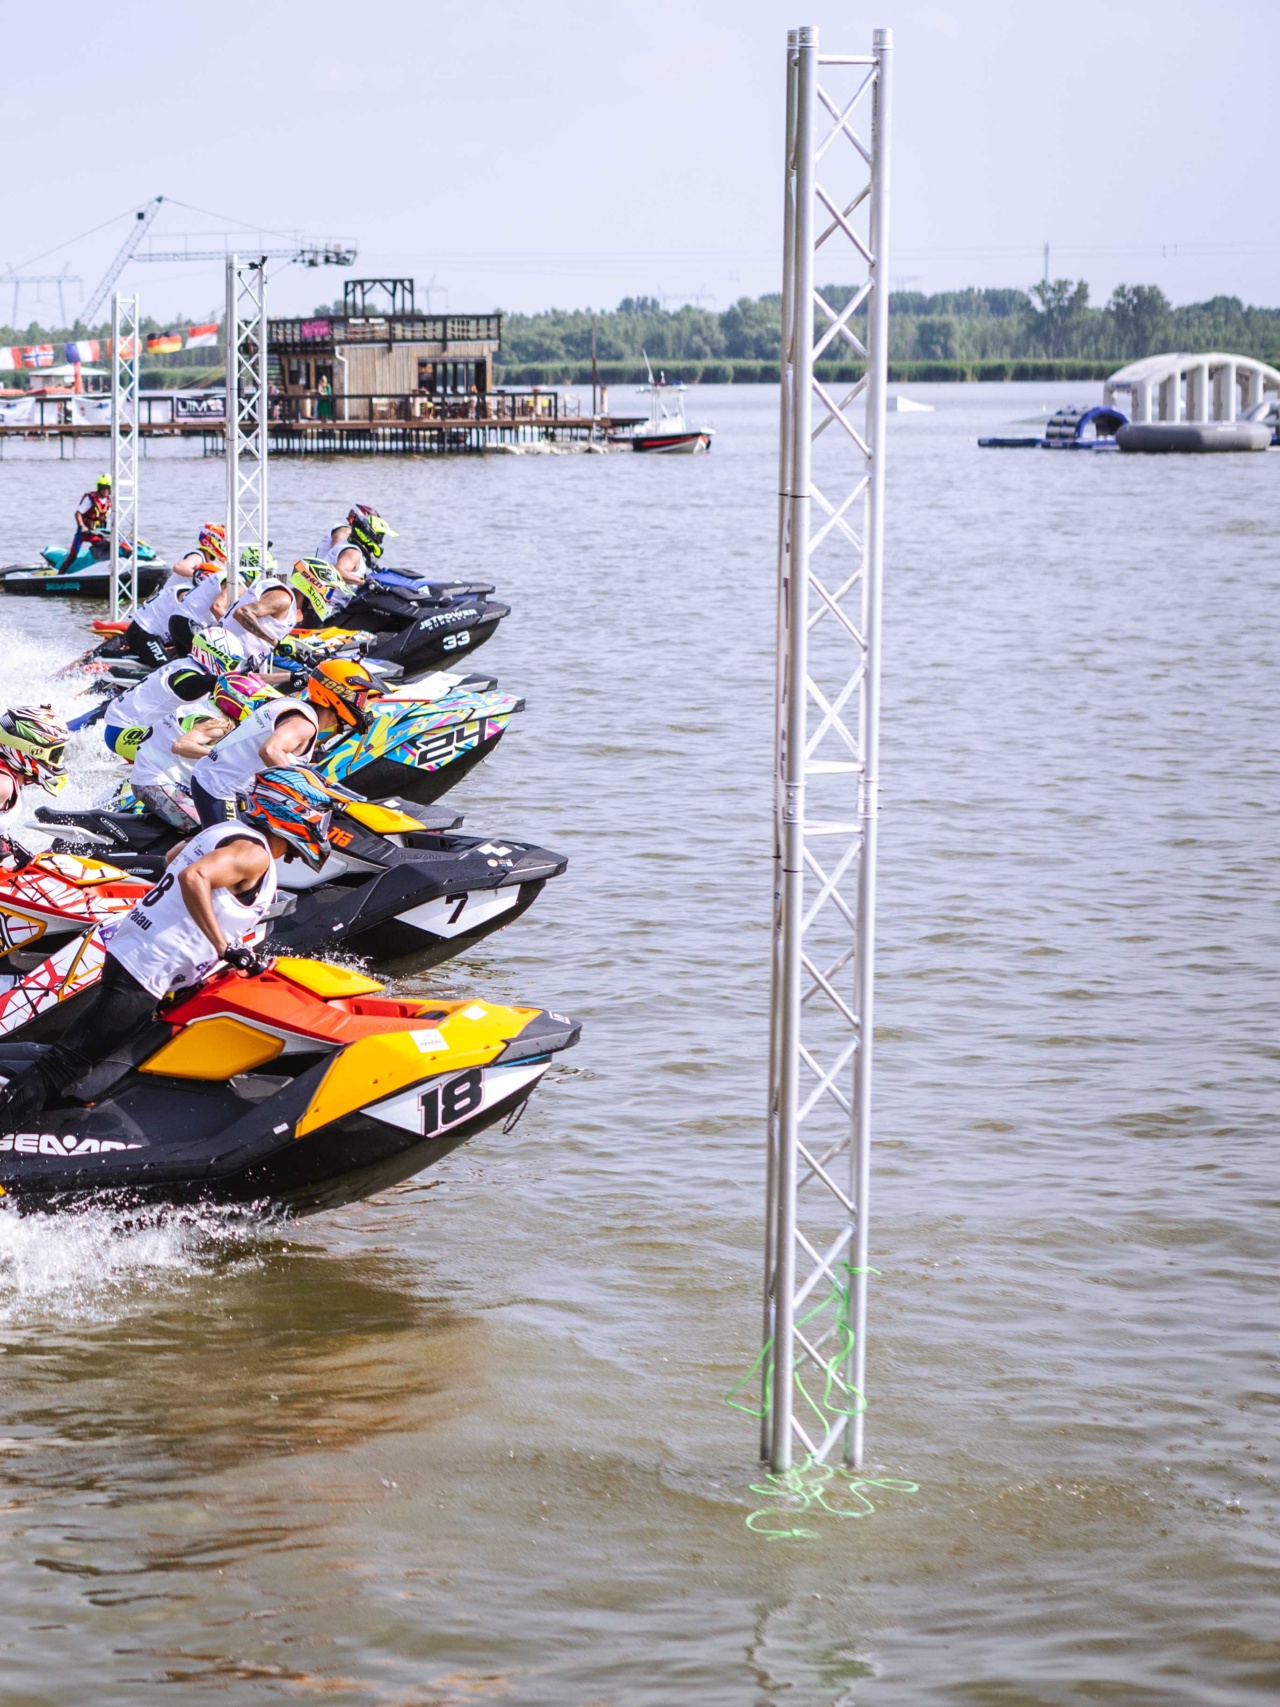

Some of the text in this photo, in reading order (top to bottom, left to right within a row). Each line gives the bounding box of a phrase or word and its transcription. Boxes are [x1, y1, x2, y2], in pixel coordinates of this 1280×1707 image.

[177, 400, 207, 412] UIM
[308, 586, 325, 610] SHOT
[420, 608, 478, 630] JETPOWER
[443, 630, 470, 650] 33
[321, 677, 356, 702] 100%
[417, 717, 486, 766] 24
[445, 892, 468, 924] 7
[420, 1068, 484, 1138] 18
